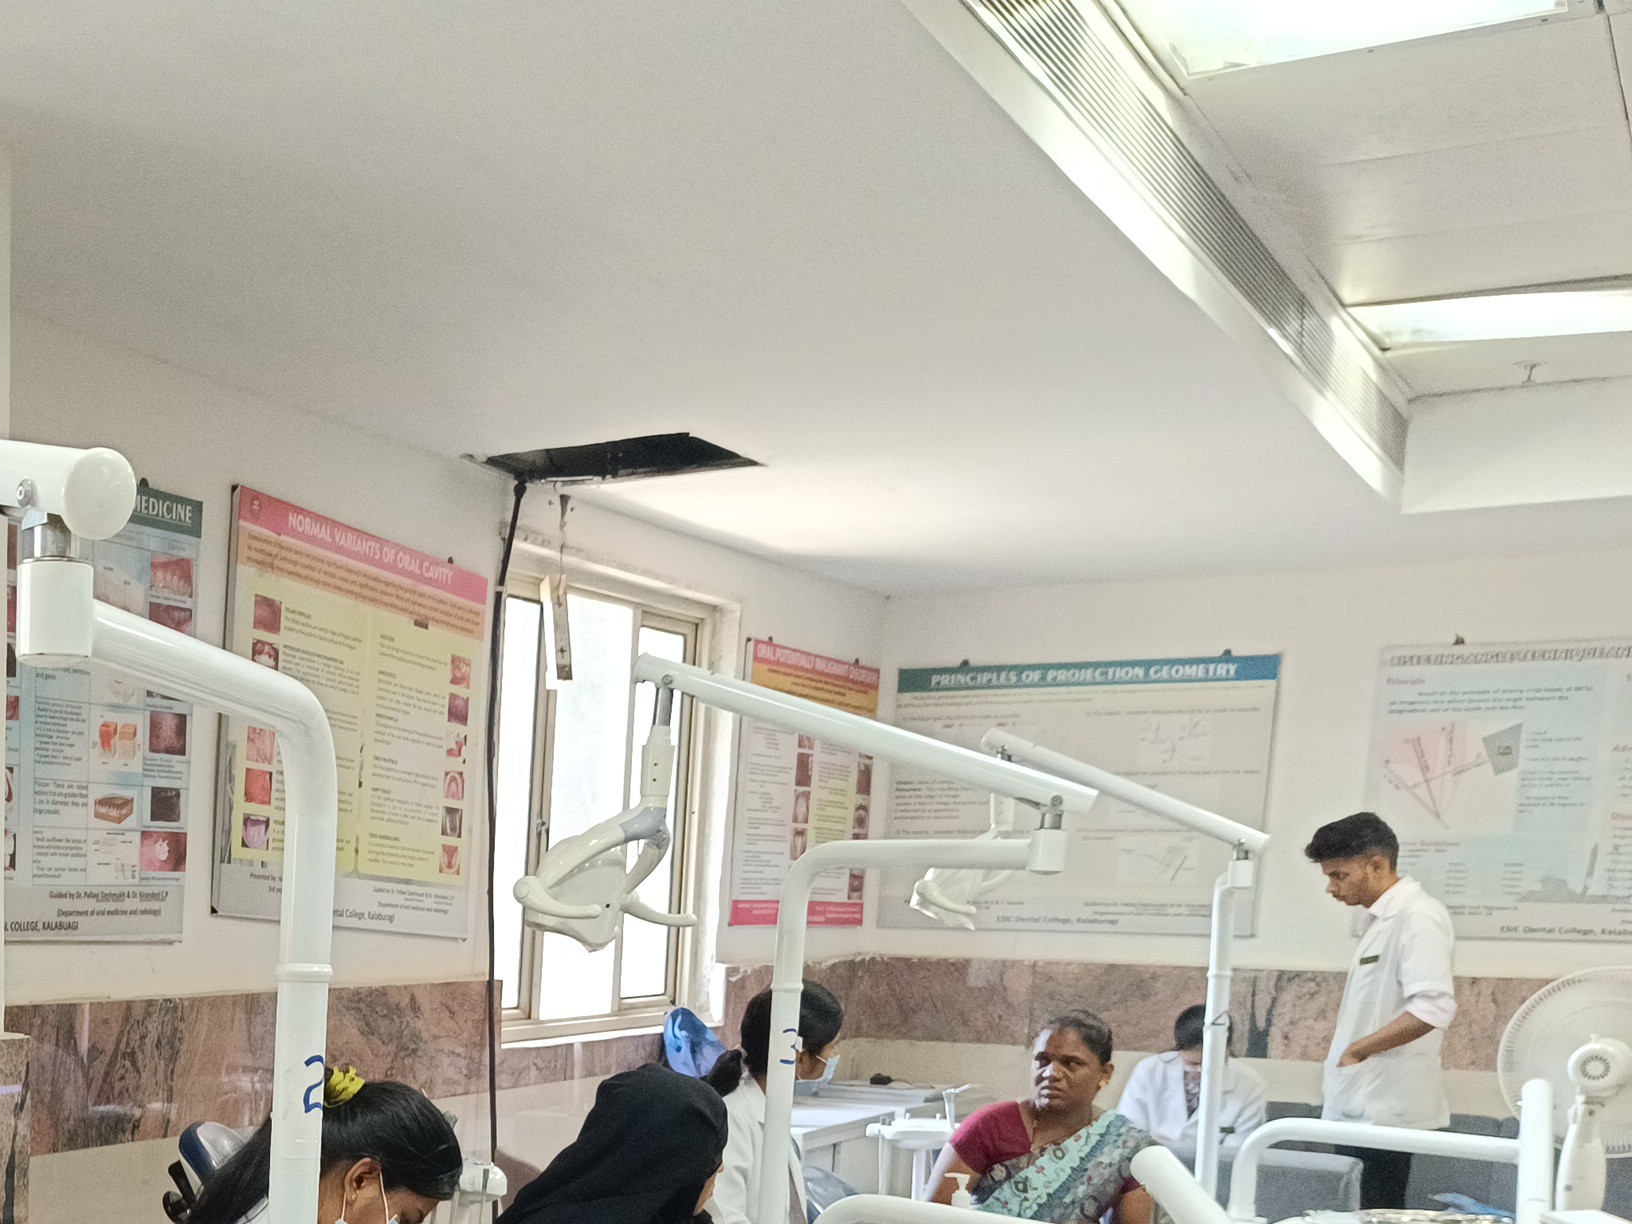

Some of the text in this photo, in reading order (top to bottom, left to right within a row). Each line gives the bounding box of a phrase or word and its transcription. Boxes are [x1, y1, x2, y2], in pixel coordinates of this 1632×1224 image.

[135, 494, 193, 524] MEDICINE
[288, 512, 455, 586] NORMAL VARIANTS OF ORAL CAVITY
[930, 662, 1238, 688] PRINCIPLES OF PROJECTION GEOMETRY
[49, 891, 68, 900] Guided
[57, 908, 89, 918] (Department
[345, 908, 367, 921] College,
[10, 921, 41, 933] COLLEGE,
[303, 1054, 325, 1114] 2
